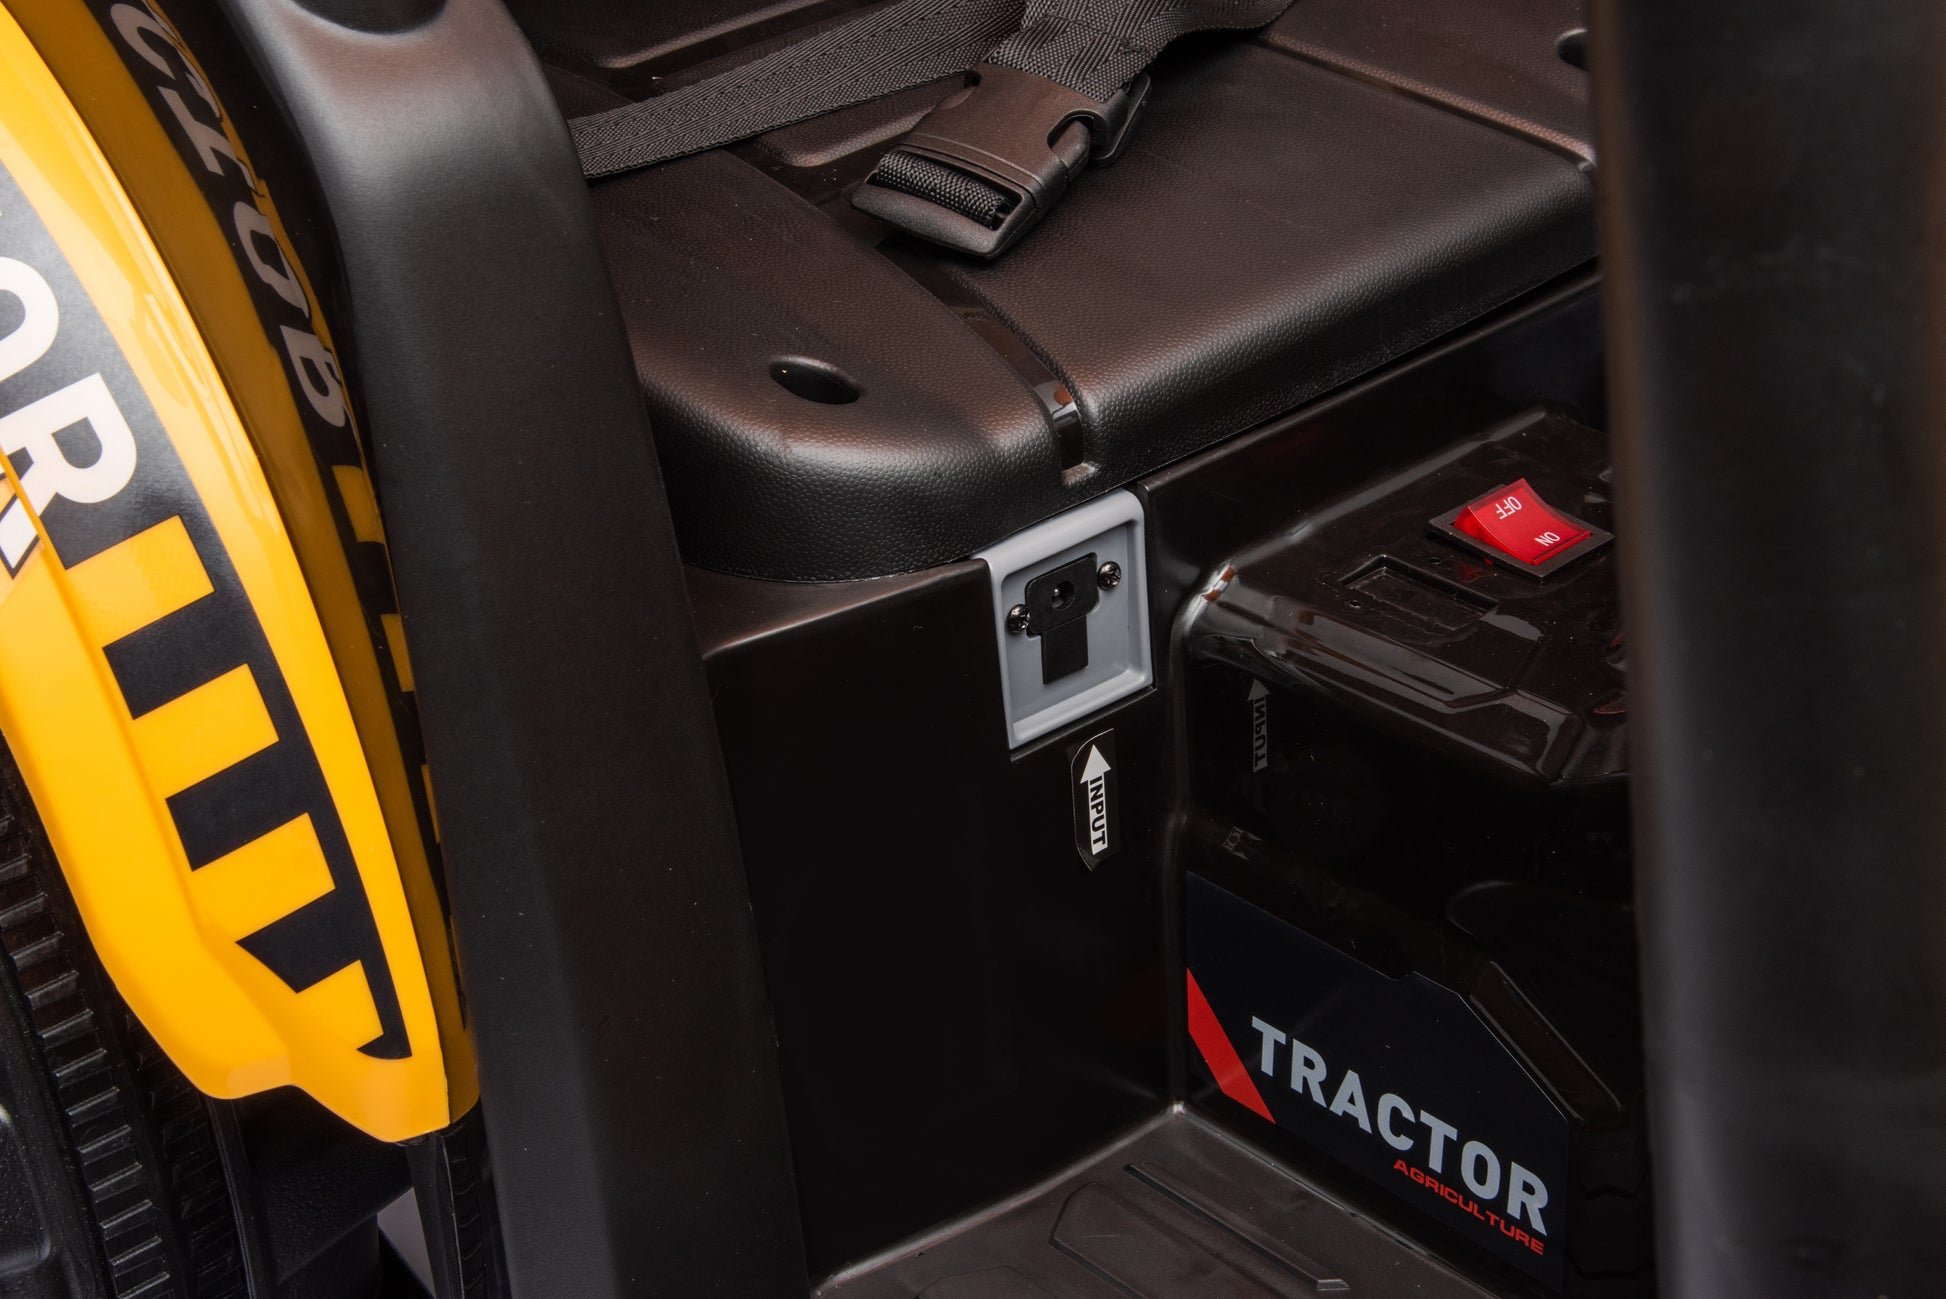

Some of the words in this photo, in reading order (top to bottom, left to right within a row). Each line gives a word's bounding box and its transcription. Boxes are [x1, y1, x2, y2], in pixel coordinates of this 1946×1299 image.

[1495, 496, 1523, 520] OFF
[1534, 531, 1561, 547] ON
[1089, 775, 1107, 847] INPUT
[1251, 1015, 1549, 1236] TRACTOR
[1393, 1159, 1544, 1255] AGRICULTURE
